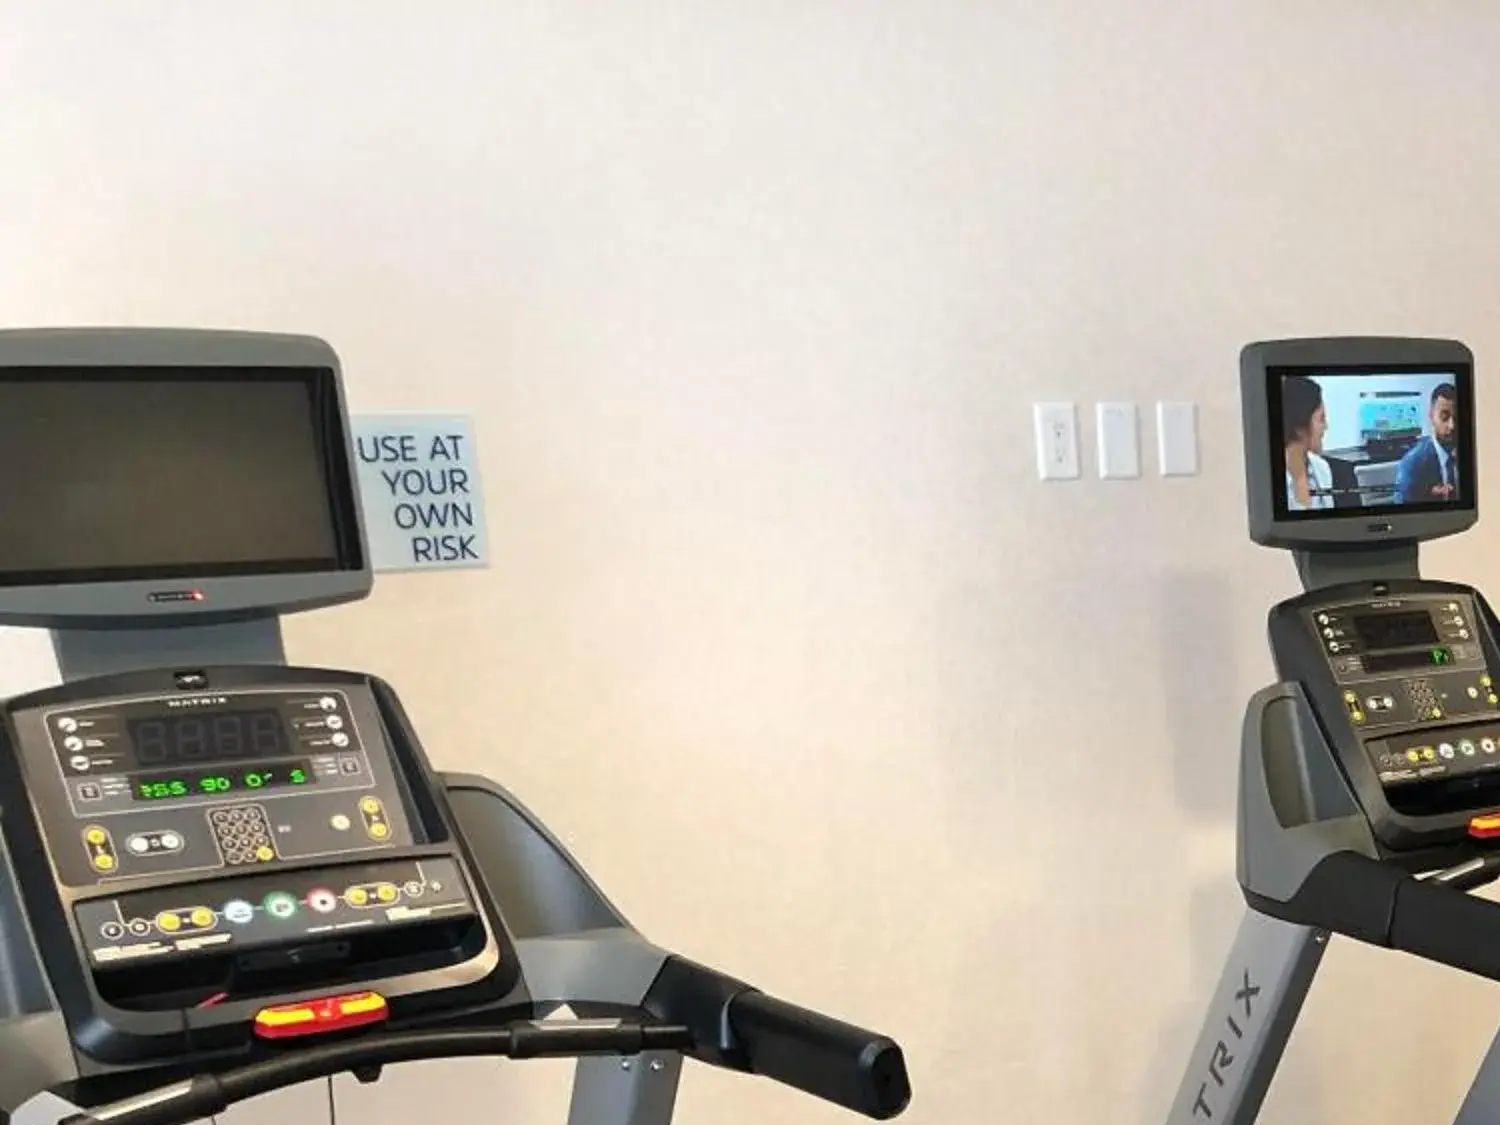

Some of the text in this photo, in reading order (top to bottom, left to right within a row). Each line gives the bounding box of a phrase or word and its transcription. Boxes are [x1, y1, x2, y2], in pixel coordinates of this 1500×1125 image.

[358, 435, 463, 462] USE AT
[381, 468, 470, 496] YOUR
[394, 502, 473, 529] OWN
[412, 535, 479, 562] RISK
